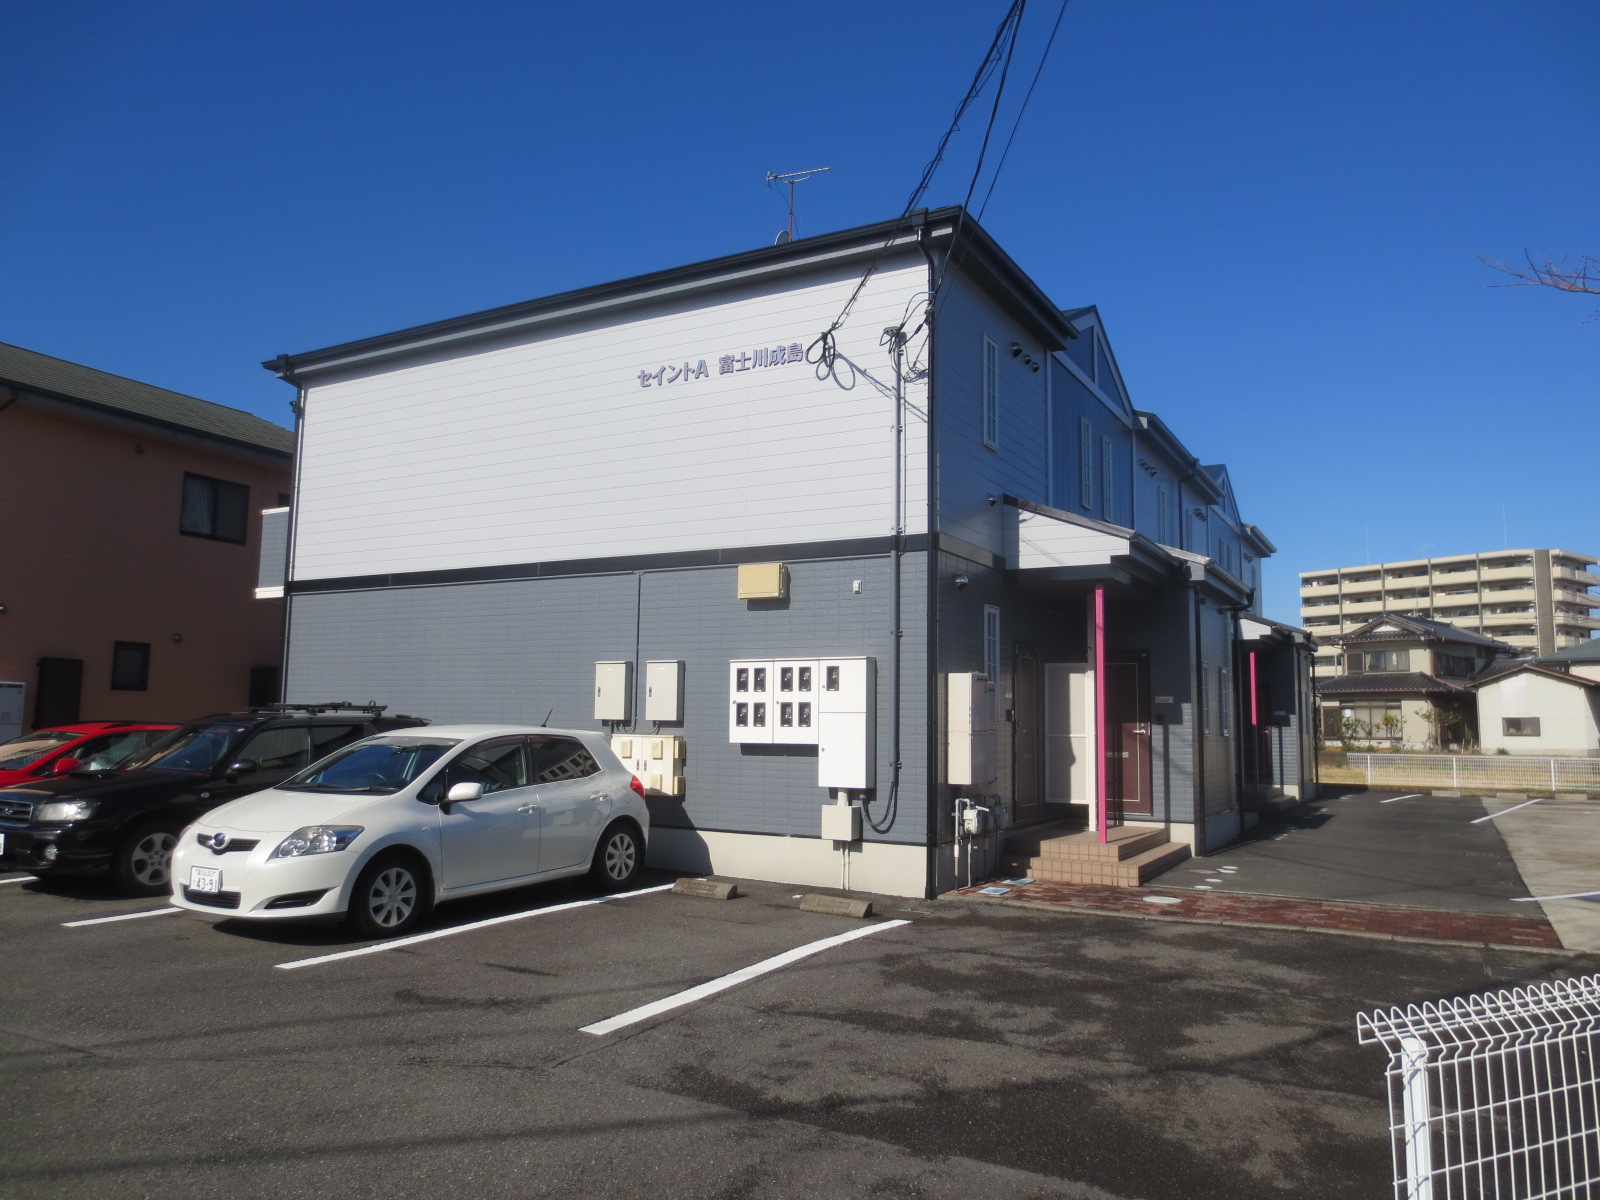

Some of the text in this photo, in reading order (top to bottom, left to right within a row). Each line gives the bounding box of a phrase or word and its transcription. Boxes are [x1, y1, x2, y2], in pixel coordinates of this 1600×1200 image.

[637, 342, 804, 388] セイントA 富士川成島
